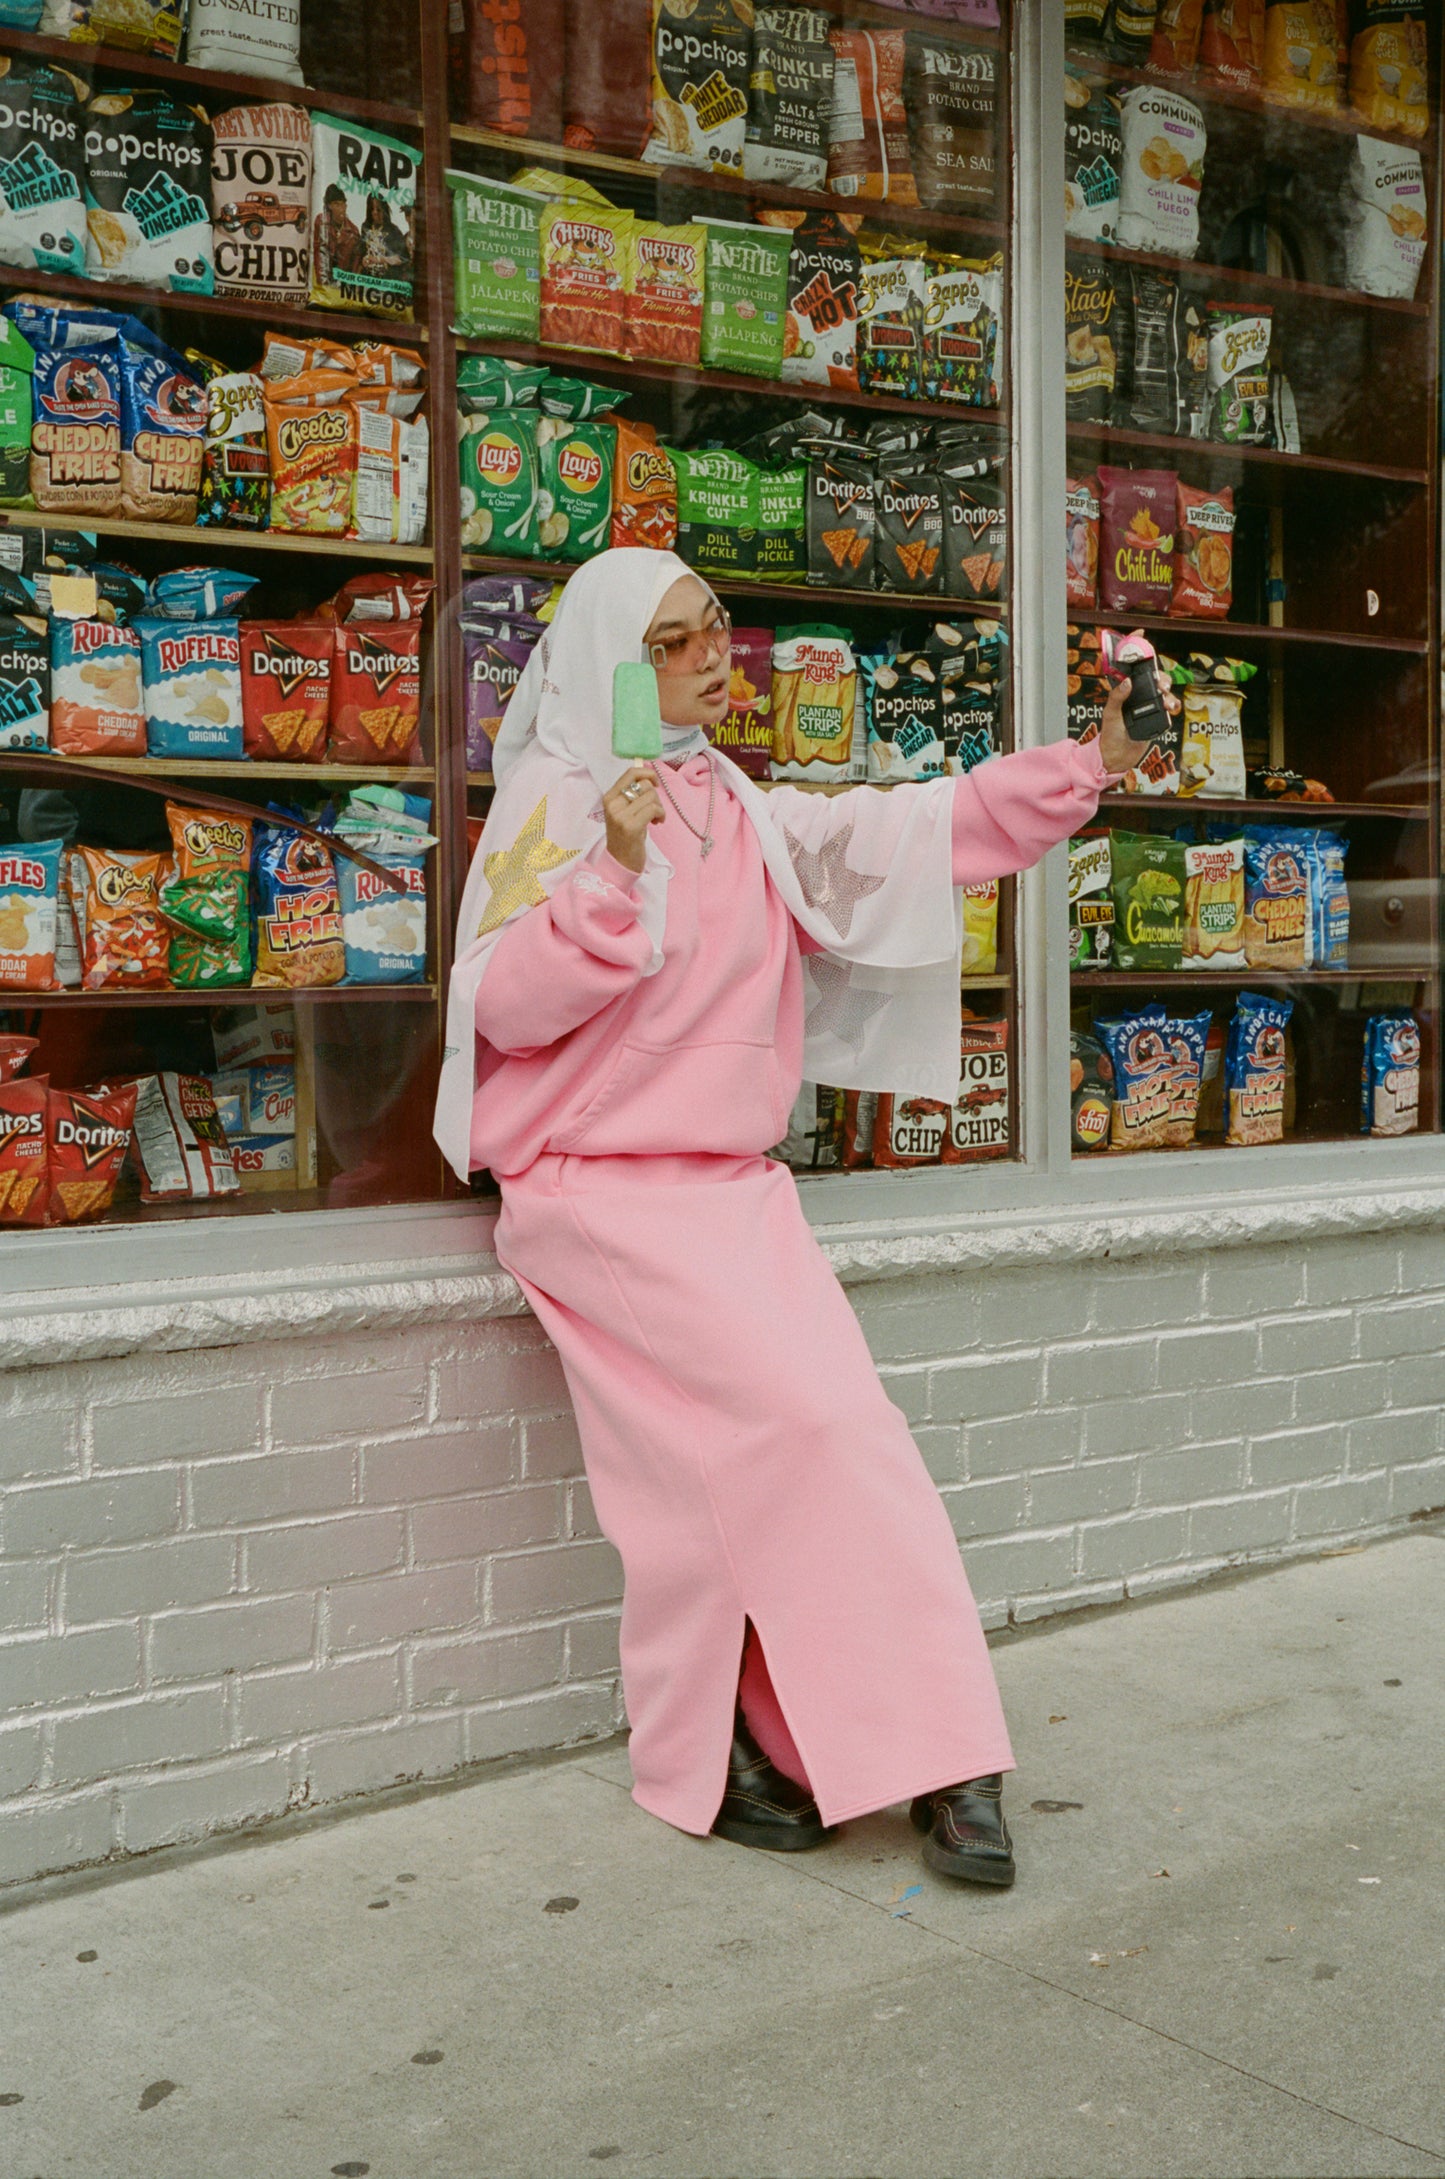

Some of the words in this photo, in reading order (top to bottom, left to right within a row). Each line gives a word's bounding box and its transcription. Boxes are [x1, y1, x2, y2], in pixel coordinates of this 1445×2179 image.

[657, 28, 748, 68] popchips
[758, 48, 834, 80] KRINKLE
[691, 72, 725, 111] WHITE
[776, 74, 811, 92] CUT
[949, 81, 980, 95] BRAND
[696, 89, 745, 131] CHEDDAR
[779, 101, 806, 119] SALT
[927, 93, 970, 110] POTATO
[773, 124, 821, 146] PEPPER
[84, 130, 204, 169] popchips
[937, 152, 966, 168] SEA
[211, 149, 307, 188] JOE
[338, 133, 413, 190] RAP
[89, 169, 129, 180] ORIGINAL
[4, 171, 76, 211] VINEGAR
[131, 173, 175, 226] SALT
[1147, 188, 1174, 202] CHILI
[138, 197, 205, 242] VINEGAR
[464, 189, 540, 232] KETTLE
[1156, 200, 1191, 218] FUEGO
[467, 237, 508, 255] POTATO
[551, 221, 616, 258] CHESTER'S
[214, 241, 308, 283] CHIPS
[638, 239, 696, 273] CHESTER'S
[708, 239, 783, 277] KETTLE
[571, 269, 601, 283] FRIES
[249, 289, 282, 302] POTATO
[340, 284, 408, 313] MIGOS
[470, 284, 540, 307] JALAPEÑO
[656, 288, 683, 299] FRIES
[710, 281, 749, 297] POTATO
[749, 289, 780, 303] CHIPS
[793, 272, 831, 313] CRAZY
[922, 280, 982, 325] Zapp's
[810, 283, 857, 331] HOT
[711, 324, 778, 347] JALAPEÑO
[870, 326, 913, 344] VOODOO
[940, 340, 979, 358] VOODOO
[279, 410, 347, 458] Cheetos
[51, 452, 120, 481] FRIES
[480, 444, 520, 475] Lay's
[561, 451, 600, 482] Lay's
[686, 456, 750, 483] KETTLE
[481, 491, 498, 500] Sour
[499, 491, 522, 501] Cream
[816, 476, 874, 500] Doritos
[496, 498, 516, 508] Onion
[575, 499, 599, 510] Cream
[689, 490, 749, 509] KRINKLE
[882, 493, 939, 513] Doritos
[706, 506, 731, 520] CUT
[762, 511, 787, 524] CUT
[951, 505, 1006, 524] Doritos
[1190, 508, 1212, 523] DEEP
[707, 533, 732, 546] DILL
[765, 538, 789, 550] DILL
[698, 546, 739, 560] PICKLE
[757, 550, 795, 562] PICKLE
[159, 636, 239, 671] RUFFLES
[253, 651, 331, 678] Doritos
[349, 649, 420, 675] Doritos
[794, 644, 844, 665] Munch
[804, 661, 837, 683] King
[305, 684, 329, 693] NACHO
[798, 704, 842, 721] PLANTAIN
[875, 696, 937, 719] popchips
[98, 715, 138, 731] CHEDDAR
[799, 716, 841, 733] STRIPS
[1188, 720, 1240, 738] popchips
[188, 730, 230, 744] ORIGINAL
[901, 728, 935, 760] VINEGAR
[185, 823, 245, 855] Cheetos
[1191, 850, 1235, 868] Munch
[1203, 864, 1228, 882] King
[277, 890, 339, 921] HOT
[1082, 906, 1099, 921] EVIL
[1100, 905, 1113, 920] EYE
[1200, 902, 1236, 915] PLANTAIN
[1126, 901, 1184, 945] Guacamole
[1201, 914, 1236, 928] STRIPS
[1267, 916, 1305, 941] FRIES
[269, 915, 343, 950] FRIES
[378, 958, 415, 971] ORIGINAL
[1117, 1019, 1140, 1054] ANDY
[1245, 1013, 1265, 1046] ANDY
[960, 1054, 1006, 1081] JOE
[1128, 1072, 1174, 1106] HOT
[58, 1119, 132, 1147] Doritos
[955, 1116, 1010, 1147] CHIPS
[15, 1148, 43, 1158] CHEESE
[16, 1141, 43, 1151] NACHO
